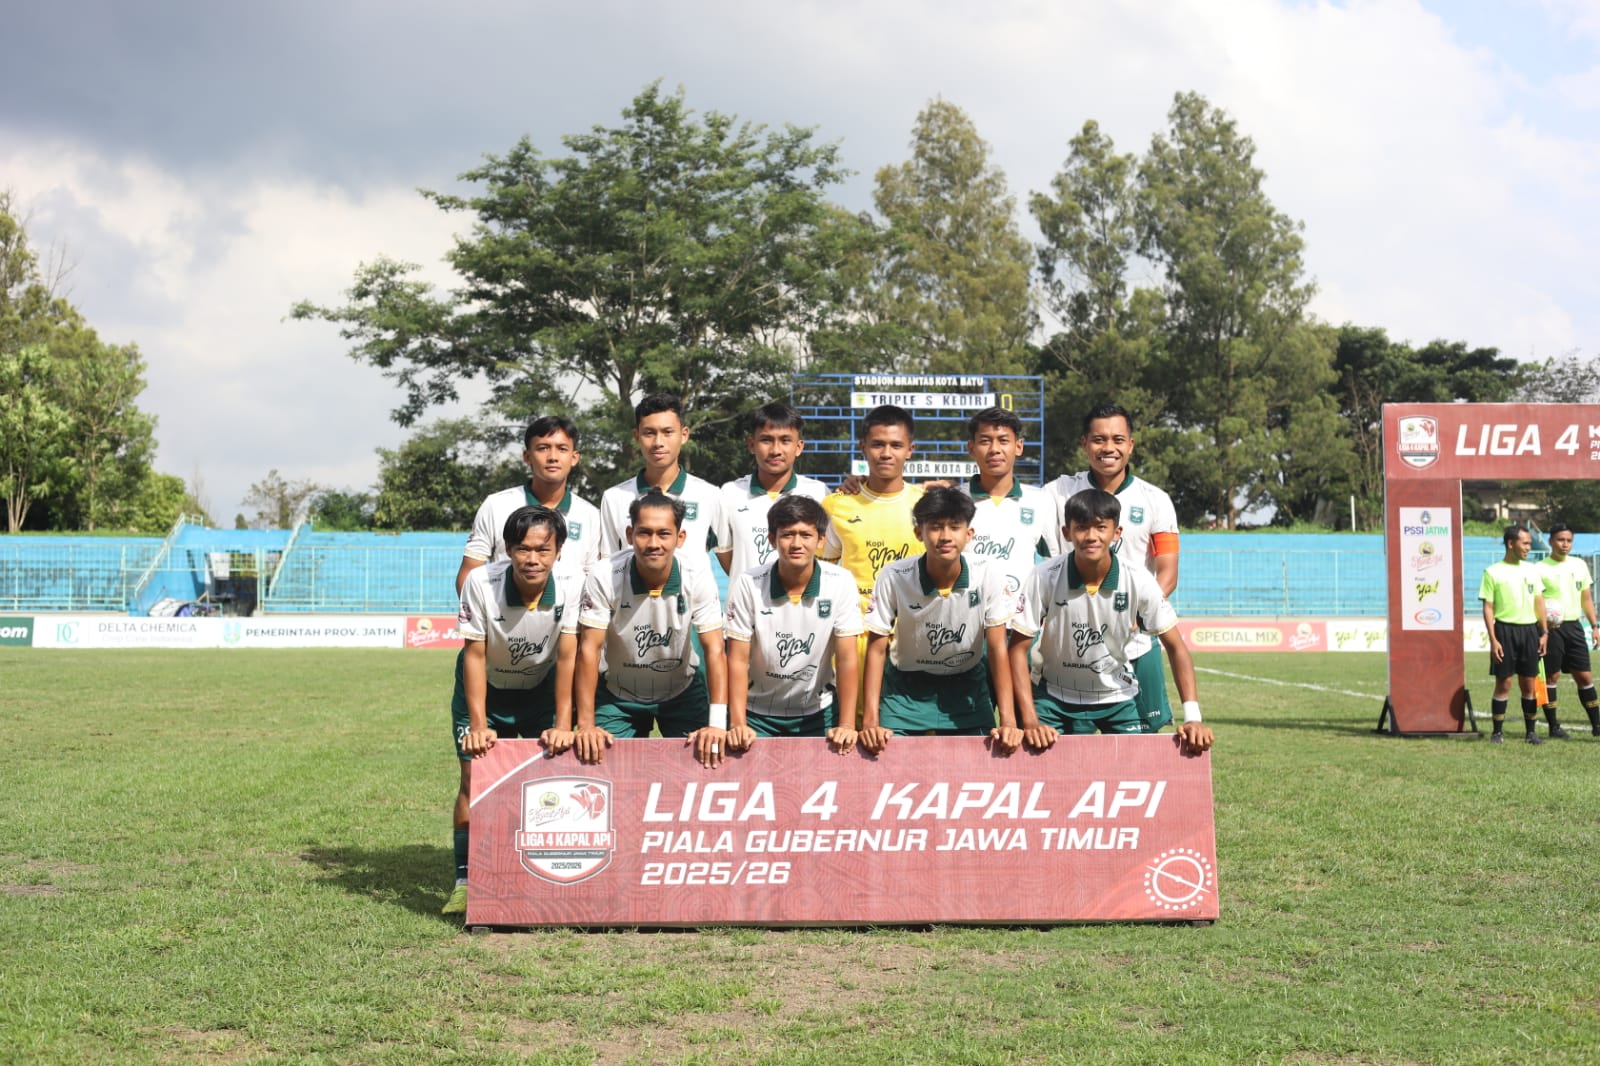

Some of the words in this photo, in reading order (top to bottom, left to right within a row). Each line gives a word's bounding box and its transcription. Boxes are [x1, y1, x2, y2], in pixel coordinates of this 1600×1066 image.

[854, 377, 895, 386] STADION
[935, 377, 958, 386] KOTA
[960, 377, 983, 386] BATU
[871, 394, 916, 405] TRIPLE
[926, 395, 933, 405] S
[943, 395, 988, 406] KEDIRI
[1455, 424, 1541, 455] LIGA
[1554, 424, 1580, 455] 4
[903, 463, 931, 474] KOBA
[934, 463, 961, 474] KOTA
[965, 463, 979, 474] BA
[1404, 526, 1424, 535] PSSI
[1425, 526, 1448, 535] JATIM
[866, 540, 884, 548] Kopi
[0, 627, 28, 638] om
[98, 622, 137, 632] DELTA
[140, 622, 197, 632] CHEMICA
[246, 628, 321, 637] PEMERINTAH
[324, 628, 359, 637] PROV.
[362, 628, 396, 637] JATIM
[1195, 631, 1252, 642] SPECIAL
[1256, 631, 1279, 642] MIX
[642, 781, 776, 822] LIGA
[801, 781, 838, 821] 4
[870, 781, 1051, 820] KAPAL
[1067, 781, 1167, 818] API
[520, 832, 545, 847] LIGA
[545, 832, 553, 847] 4
[555, 832, 590, 847] KAPAL
[592, 832, 611, 846] API
[640, 830, 733, 853] PIALA
[745, 829, 928, 852] GUBERNUR
[936, 828, 1027, 851] JAWA
[1040, 827, 1139, 850] TIMUR
[640, 861, 791, 885] 2025/26
